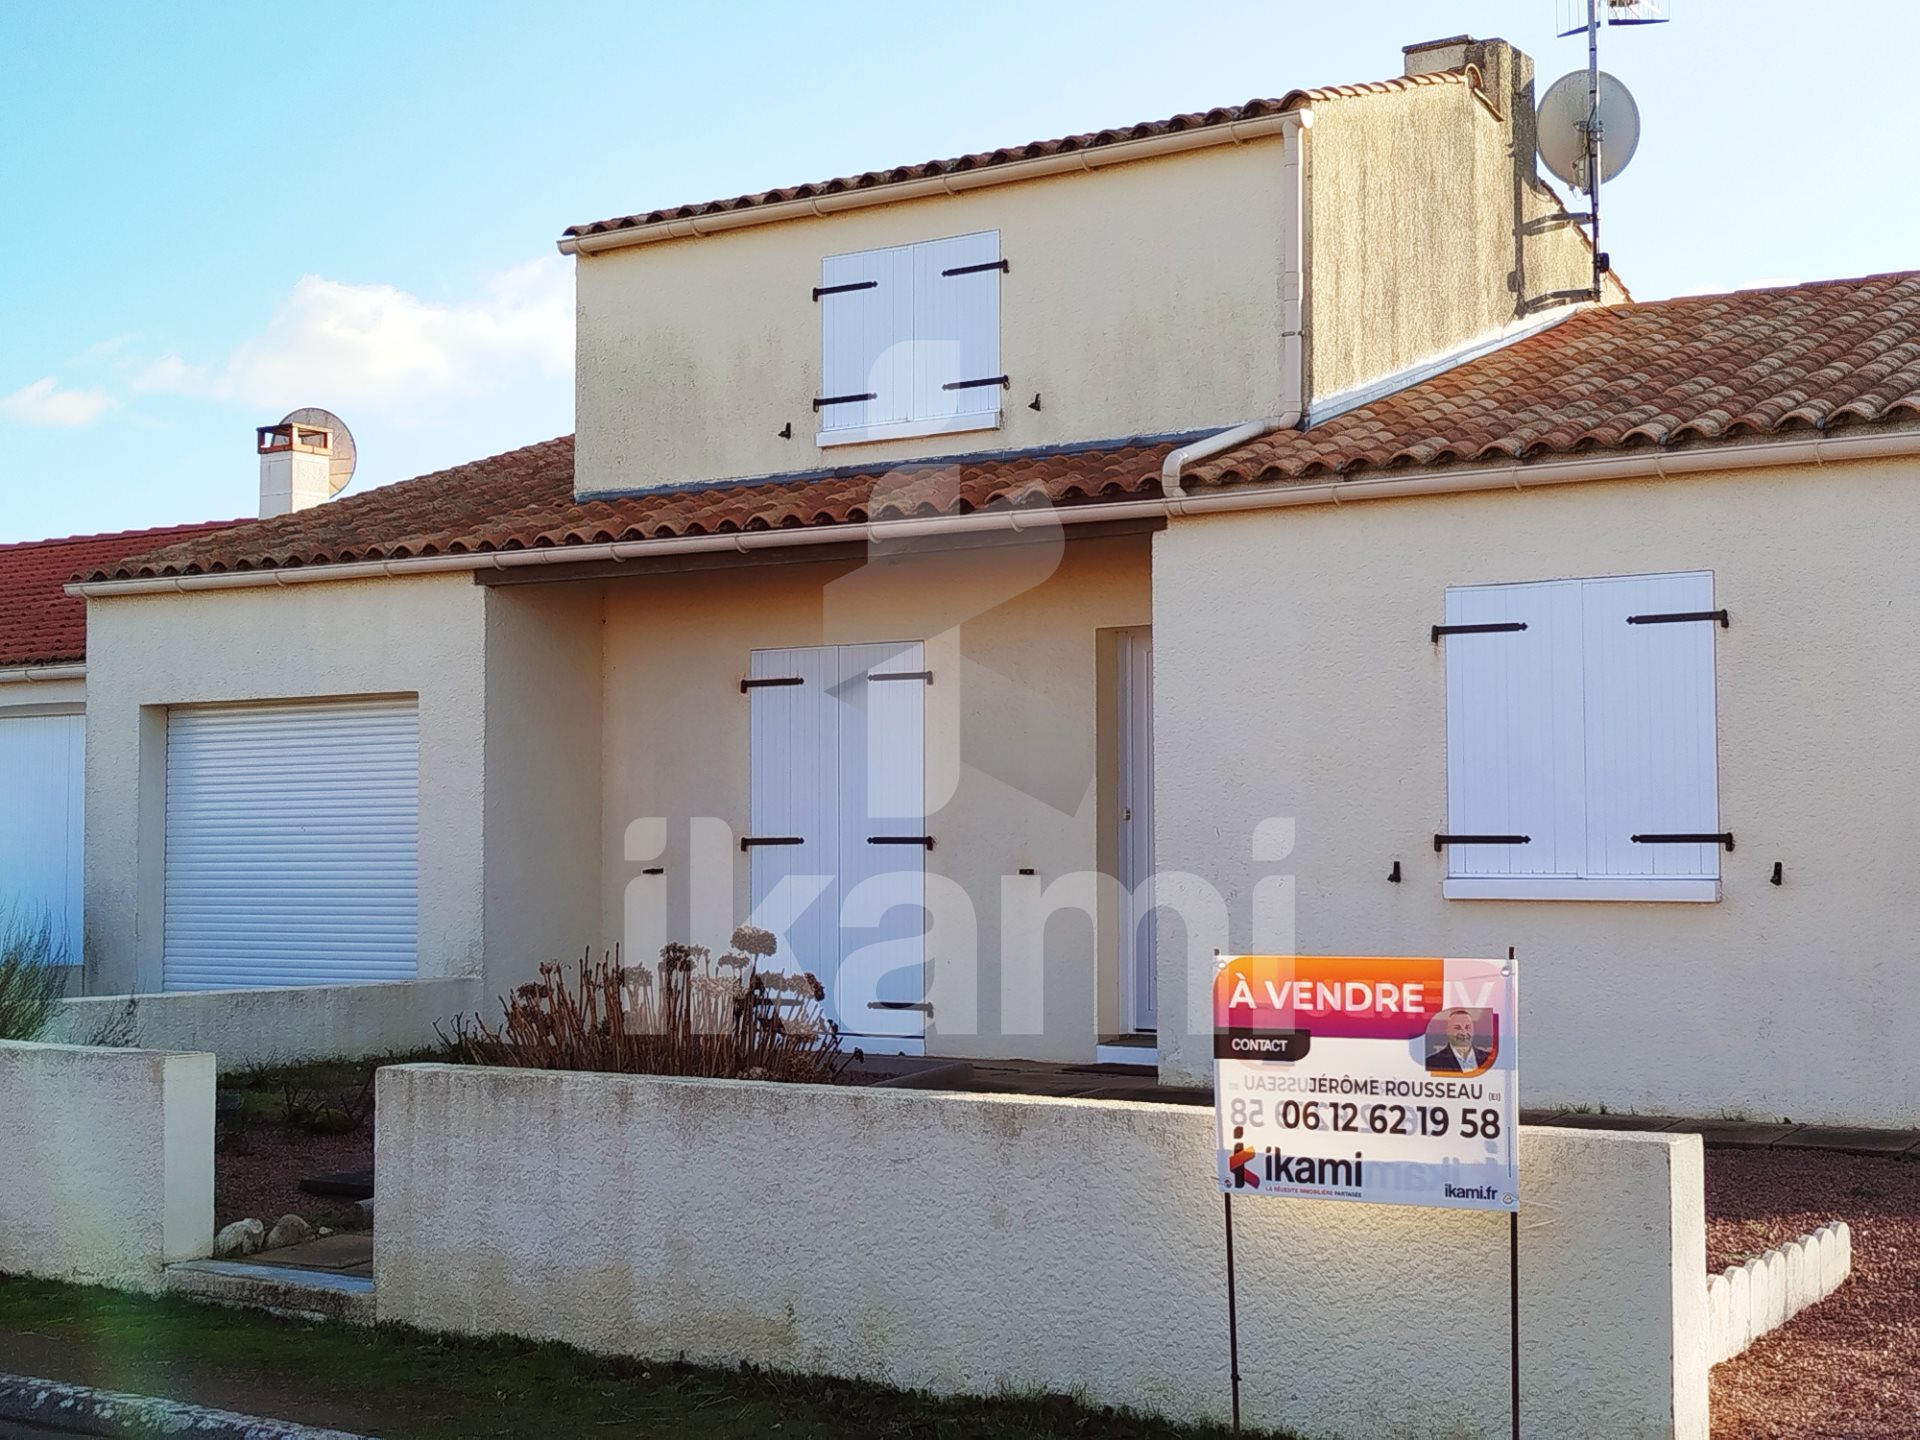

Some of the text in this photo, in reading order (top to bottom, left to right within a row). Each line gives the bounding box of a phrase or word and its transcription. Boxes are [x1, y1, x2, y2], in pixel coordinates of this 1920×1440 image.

[1228, 972, 1257, 1010] À
[1264, 981, 1425, 1013] VENDRE
[1231, 1038, 1288, 1052] CONTACT
[1308, 1073, 1380, 1096] JÉRÔME
[1385, 1080, 1483, 1100] ROUSSEAU
[1281, 1099, 1501, 1140] 06 12 62 19 58
[1265, 1145, 1363, 1188] ikami
[1444, 1183, 1498, 1200] ikami.fr
